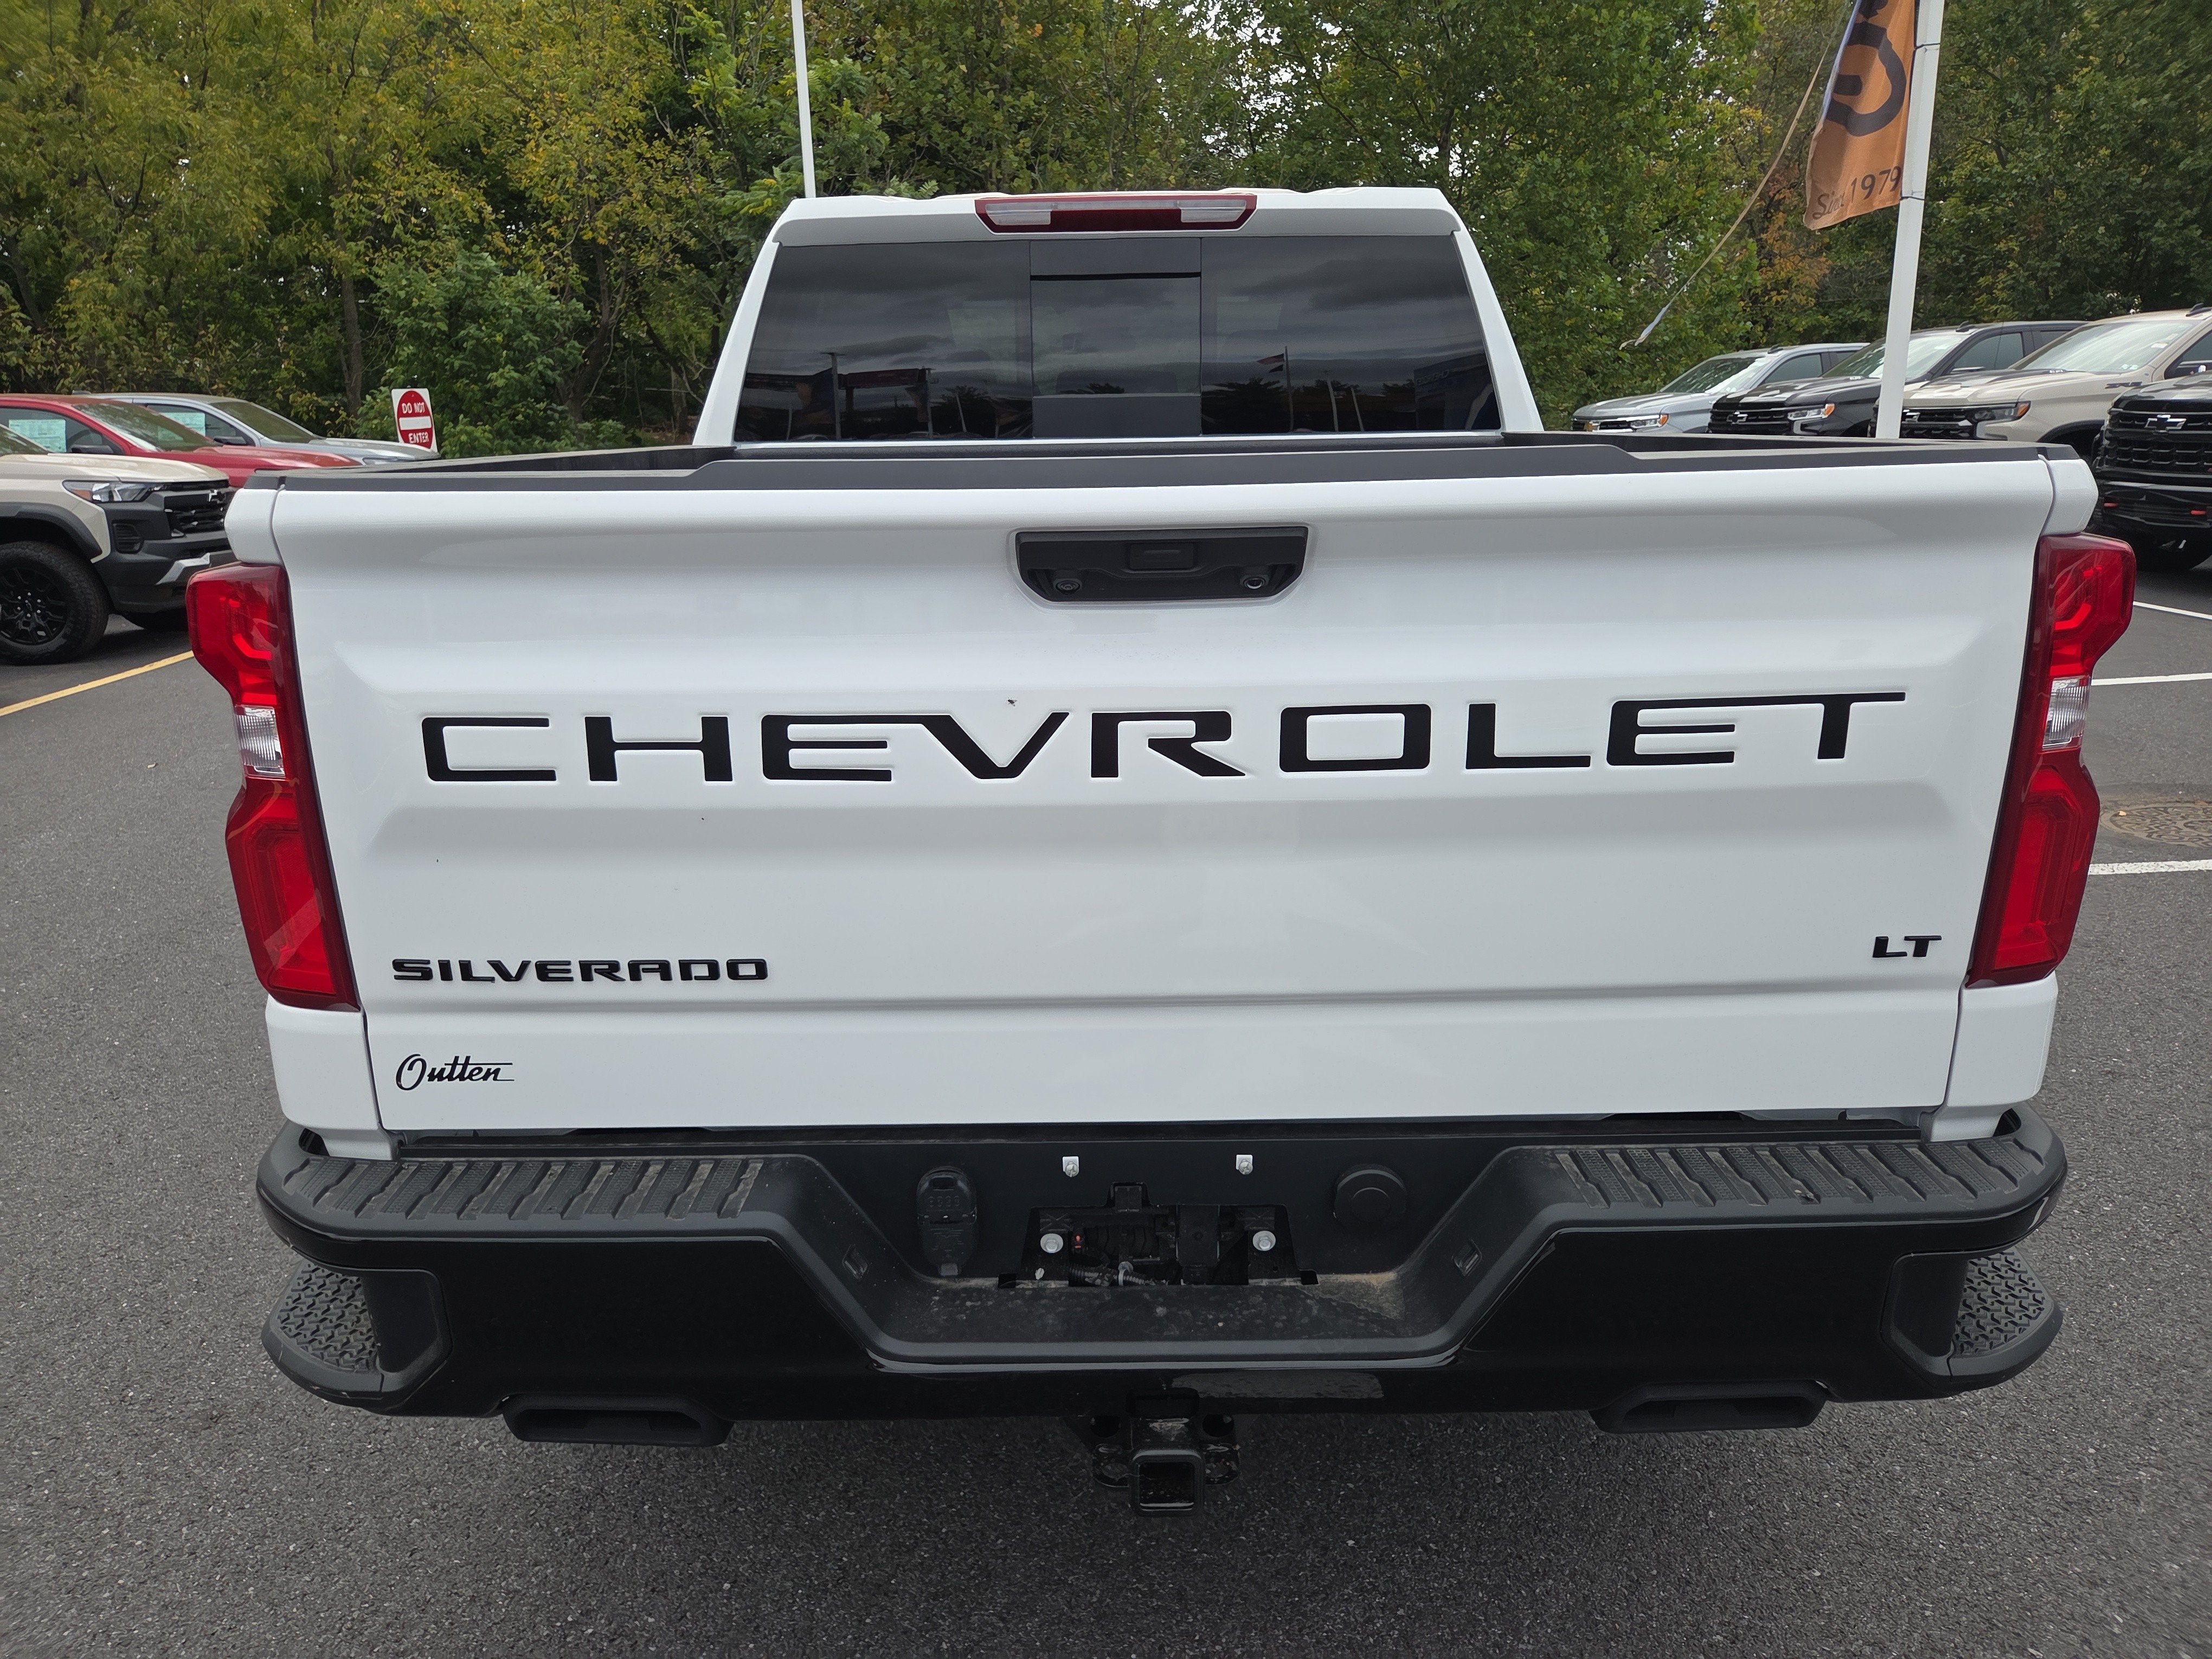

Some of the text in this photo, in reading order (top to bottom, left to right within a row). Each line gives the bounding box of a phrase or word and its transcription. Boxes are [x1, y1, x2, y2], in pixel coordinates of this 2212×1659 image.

[1850, 166, 1901, 203] 1979
[402, 402, 425, 414] DO NOT
[408, 432, 429, 443] ENTER
[421, 691, 1906, 782] CHEVROLET
[1872, 935, 1943, 959] LT
[391, 958, 769, 983] SILVERADO
[396, 1053, 515, 1091] Outten
